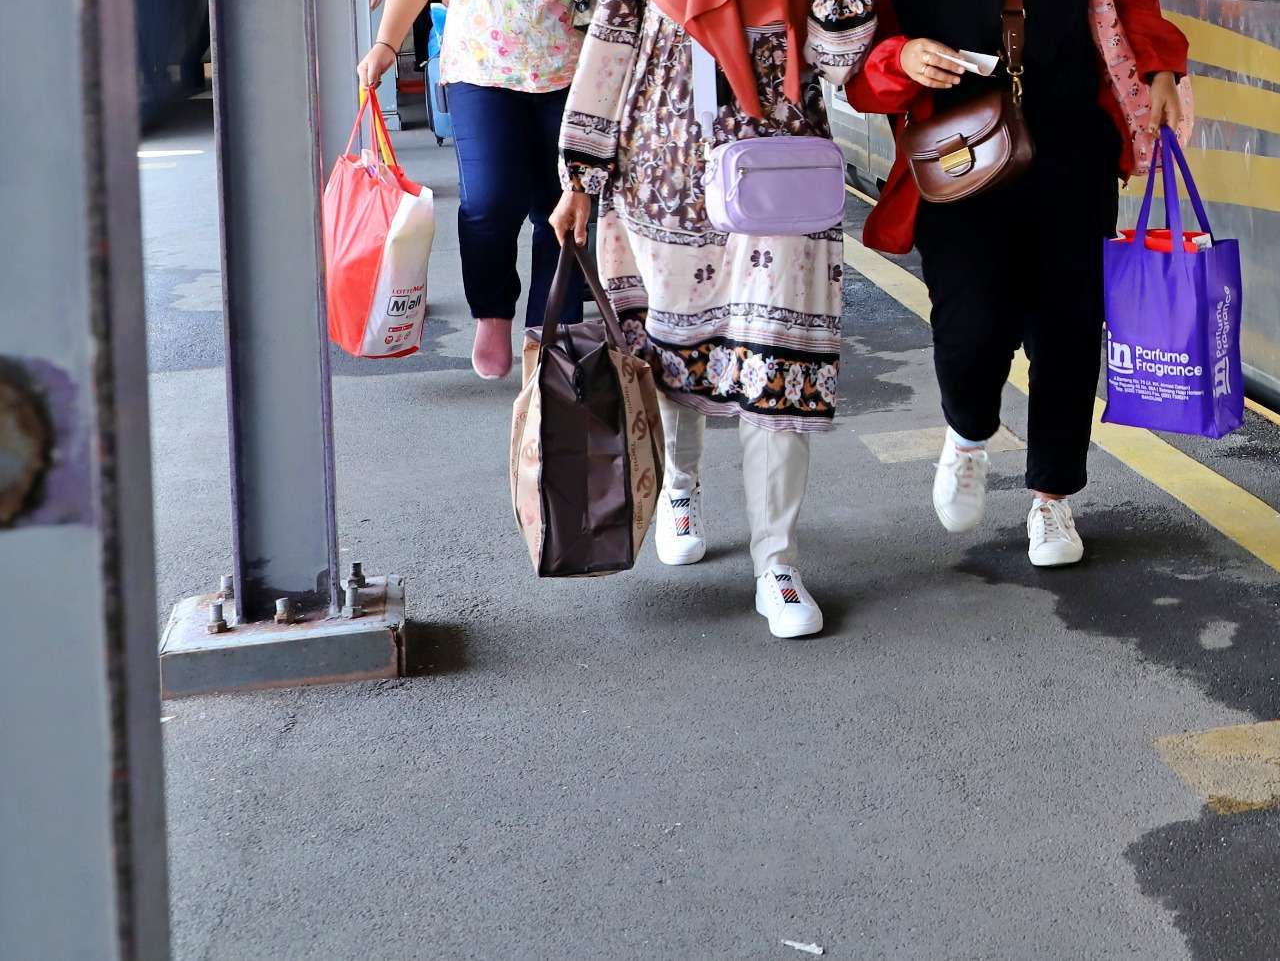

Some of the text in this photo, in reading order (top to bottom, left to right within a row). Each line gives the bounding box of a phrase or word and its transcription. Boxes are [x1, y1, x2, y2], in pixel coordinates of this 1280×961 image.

[1216, 301, 1224, 358] Parfume
[1135, 345, 1189, 364] Parfume
[1136, 358, 1203, 377] Fragrance
